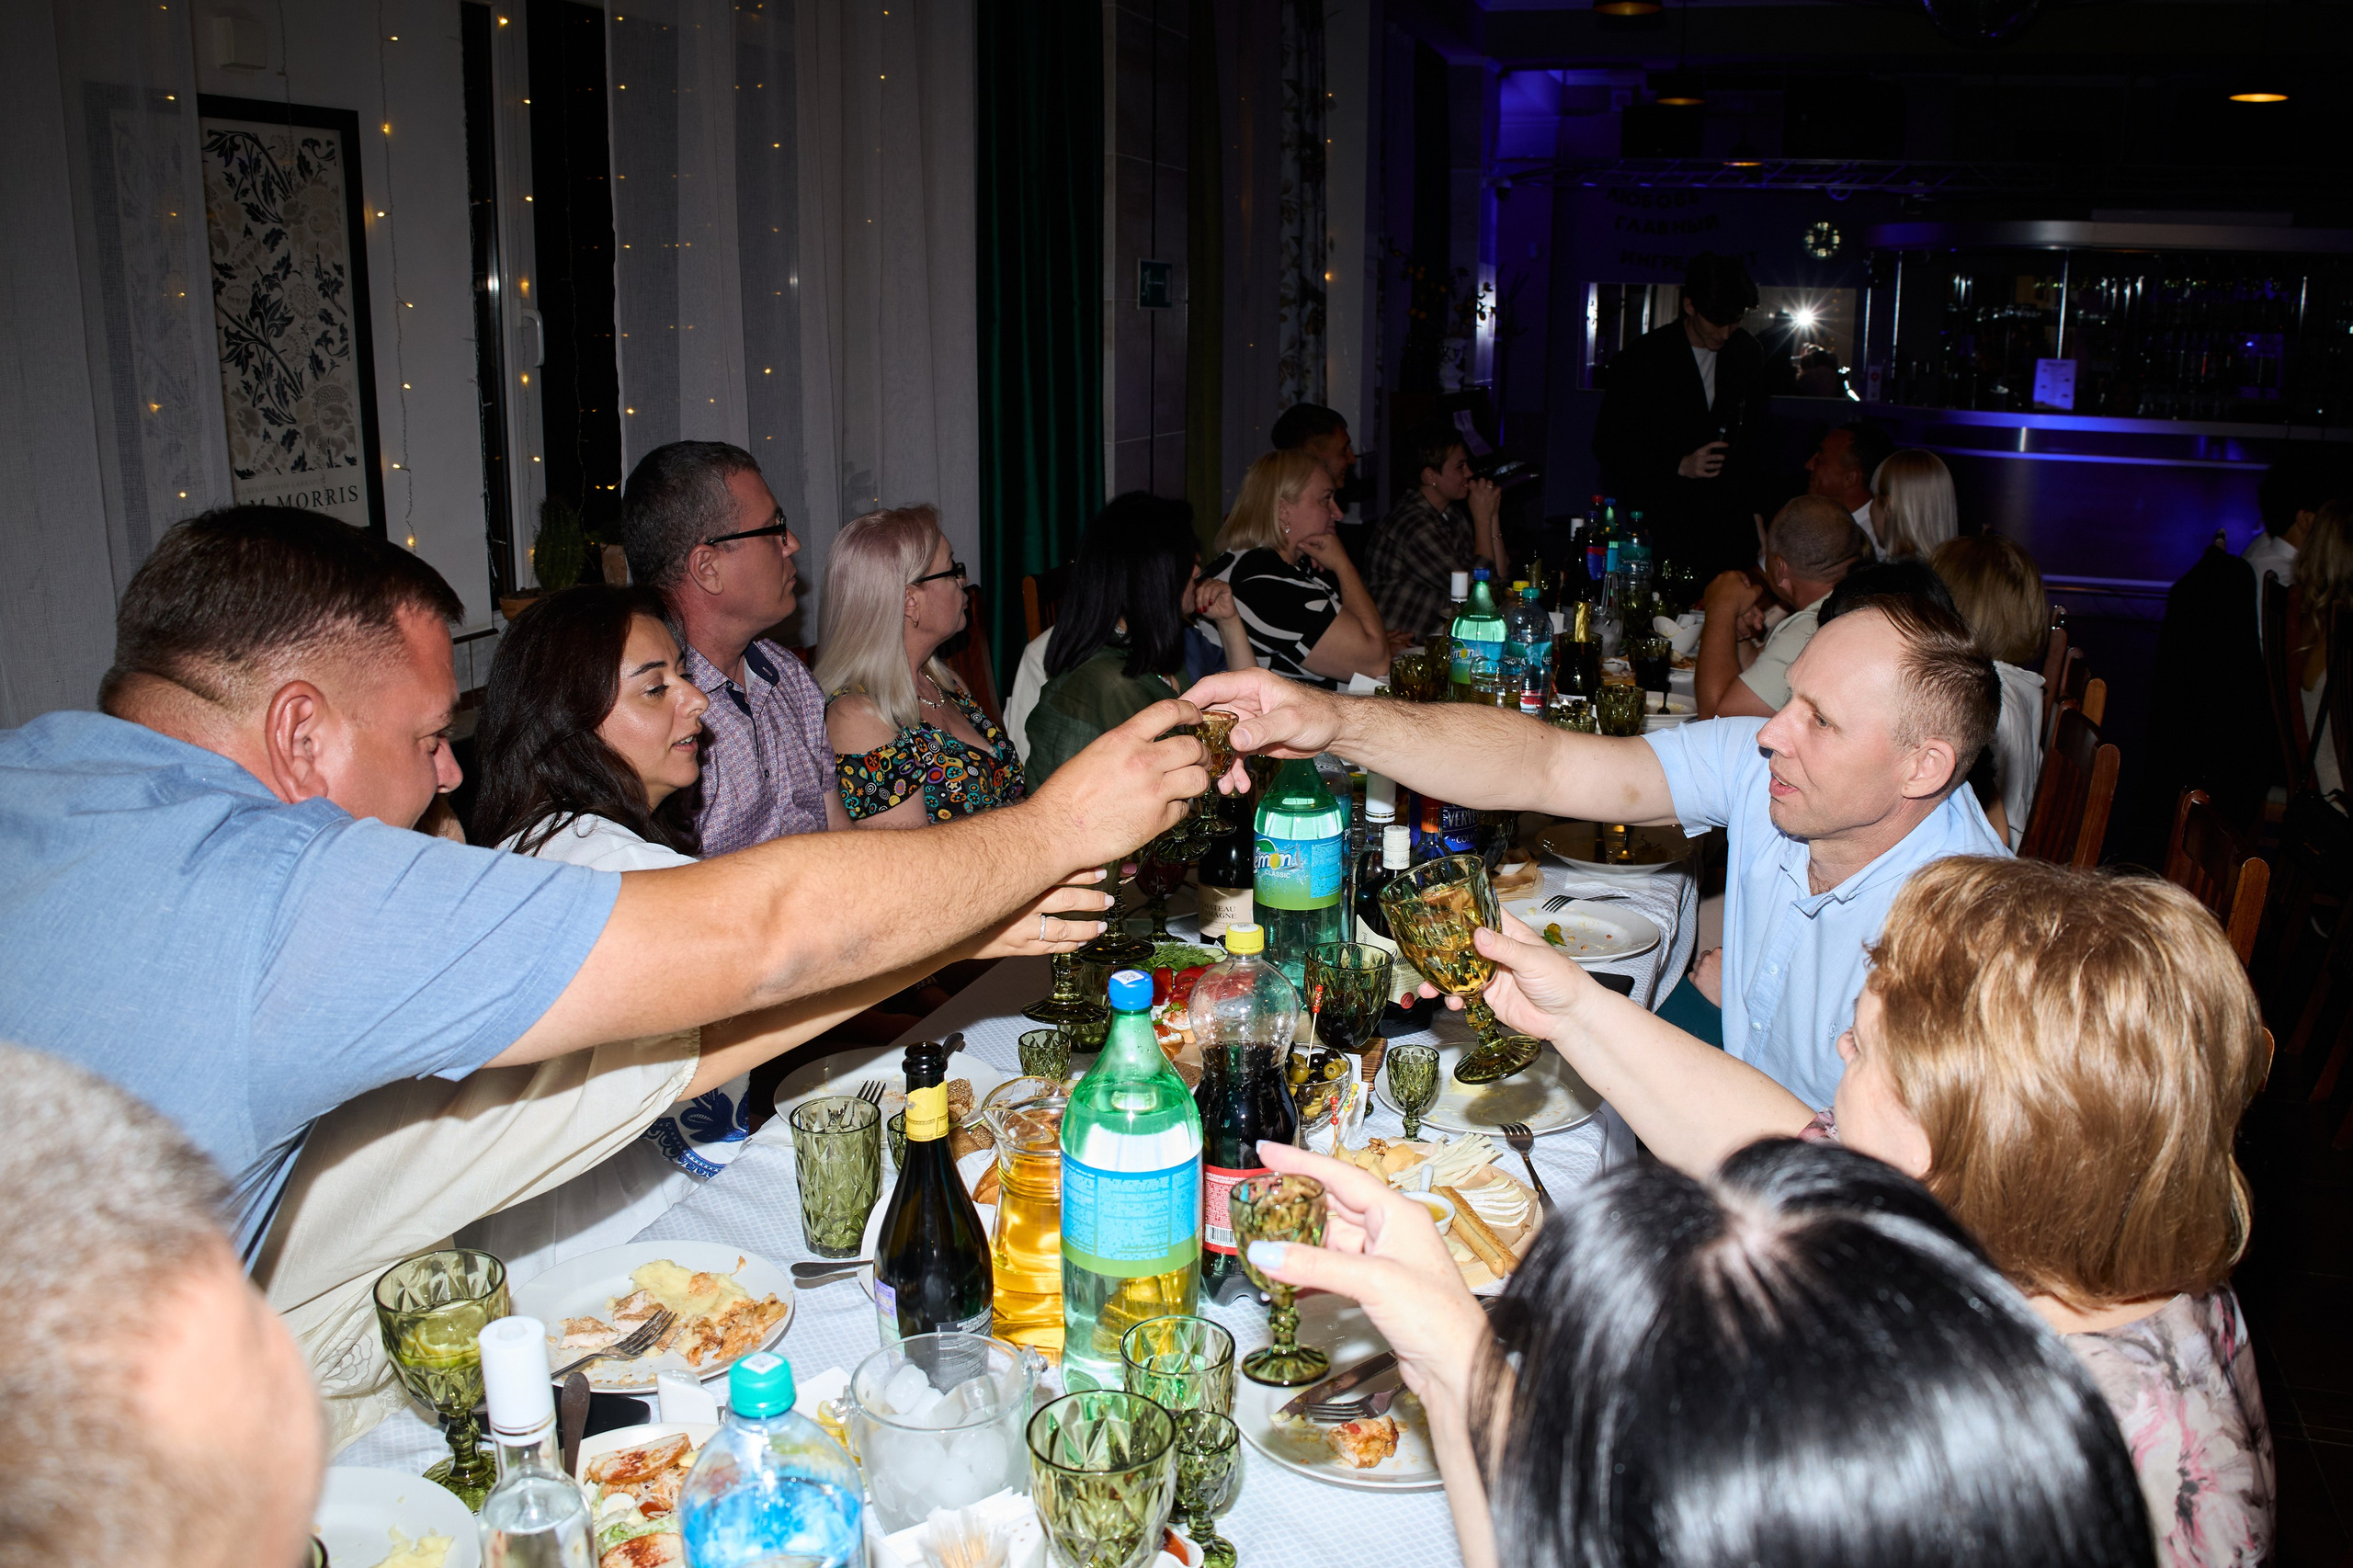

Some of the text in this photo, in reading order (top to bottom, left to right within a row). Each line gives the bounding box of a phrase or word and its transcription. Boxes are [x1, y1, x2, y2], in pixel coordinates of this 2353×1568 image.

[1606, 187, 1700, 209] ЛЮБОВЬ
[1614, 214, 1720, 235] ГЛАВНЫЙ
[1620, 249, 1758, 271] ИНГРЕТ
[277, 485, 358, 509] MORRIS
[1264, 869, 1290, 879] CLASSIC
